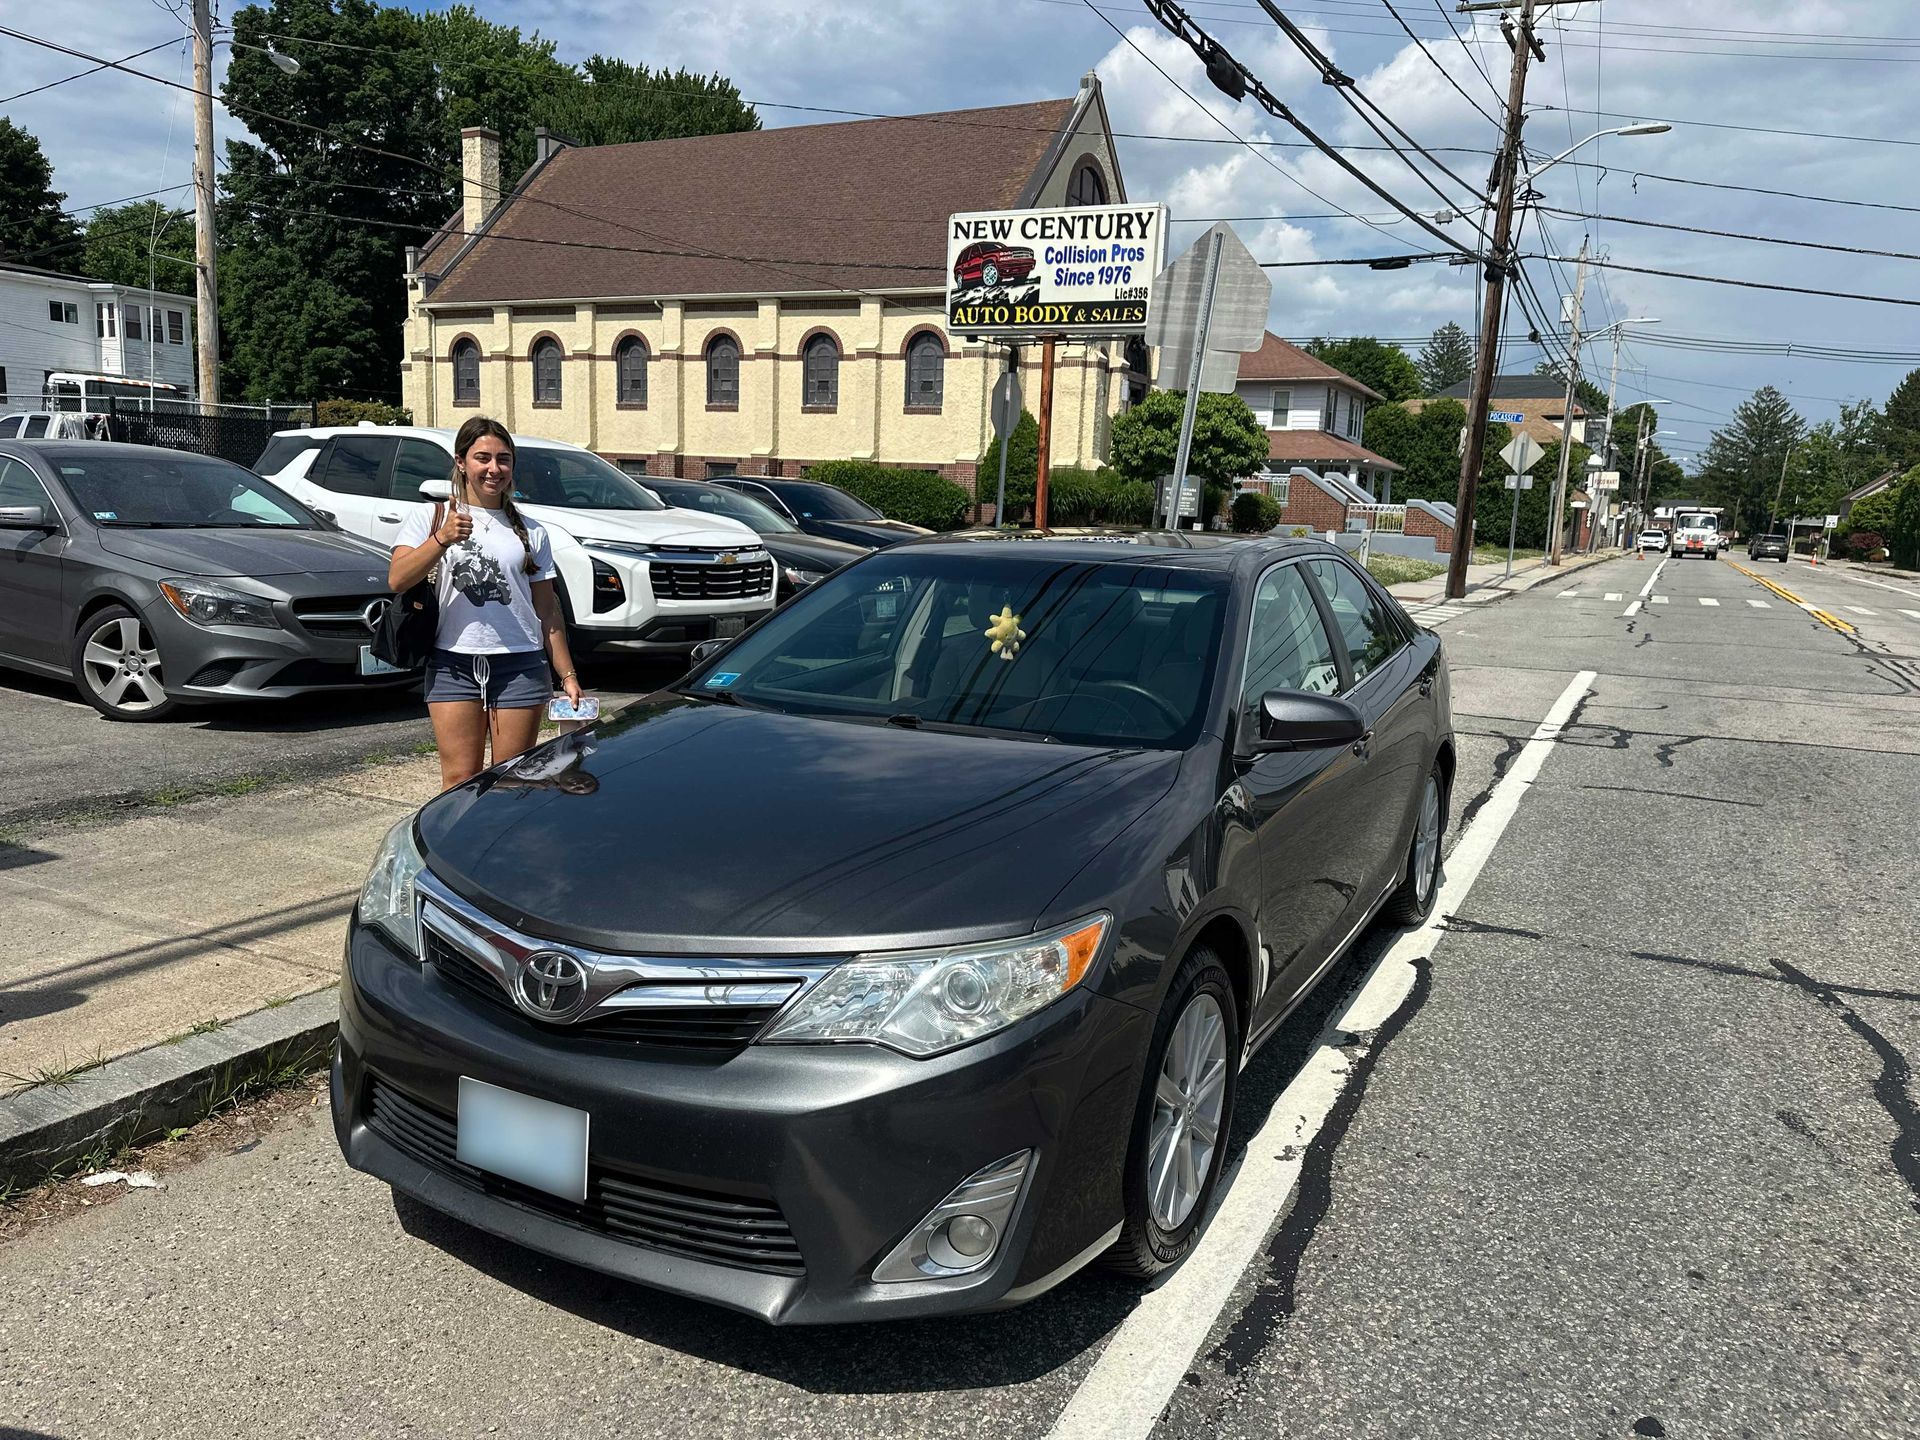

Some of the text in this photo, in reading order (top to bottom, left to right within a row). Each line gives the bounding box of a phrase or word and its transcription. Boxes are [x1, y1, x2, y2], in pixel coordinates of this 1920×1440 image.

[953, 211, 1154, 240] NEW CENTURY
[1045, 243, 1145, 265] Collision Pros
[1054, 265, 1132, 286] Since 1976
[1114, 287, 1149, 299] Lic#356
[952, 304, 1143, 325] AUTO BODY & SALES
[1489, 412, 1517, 421] POCASSET
